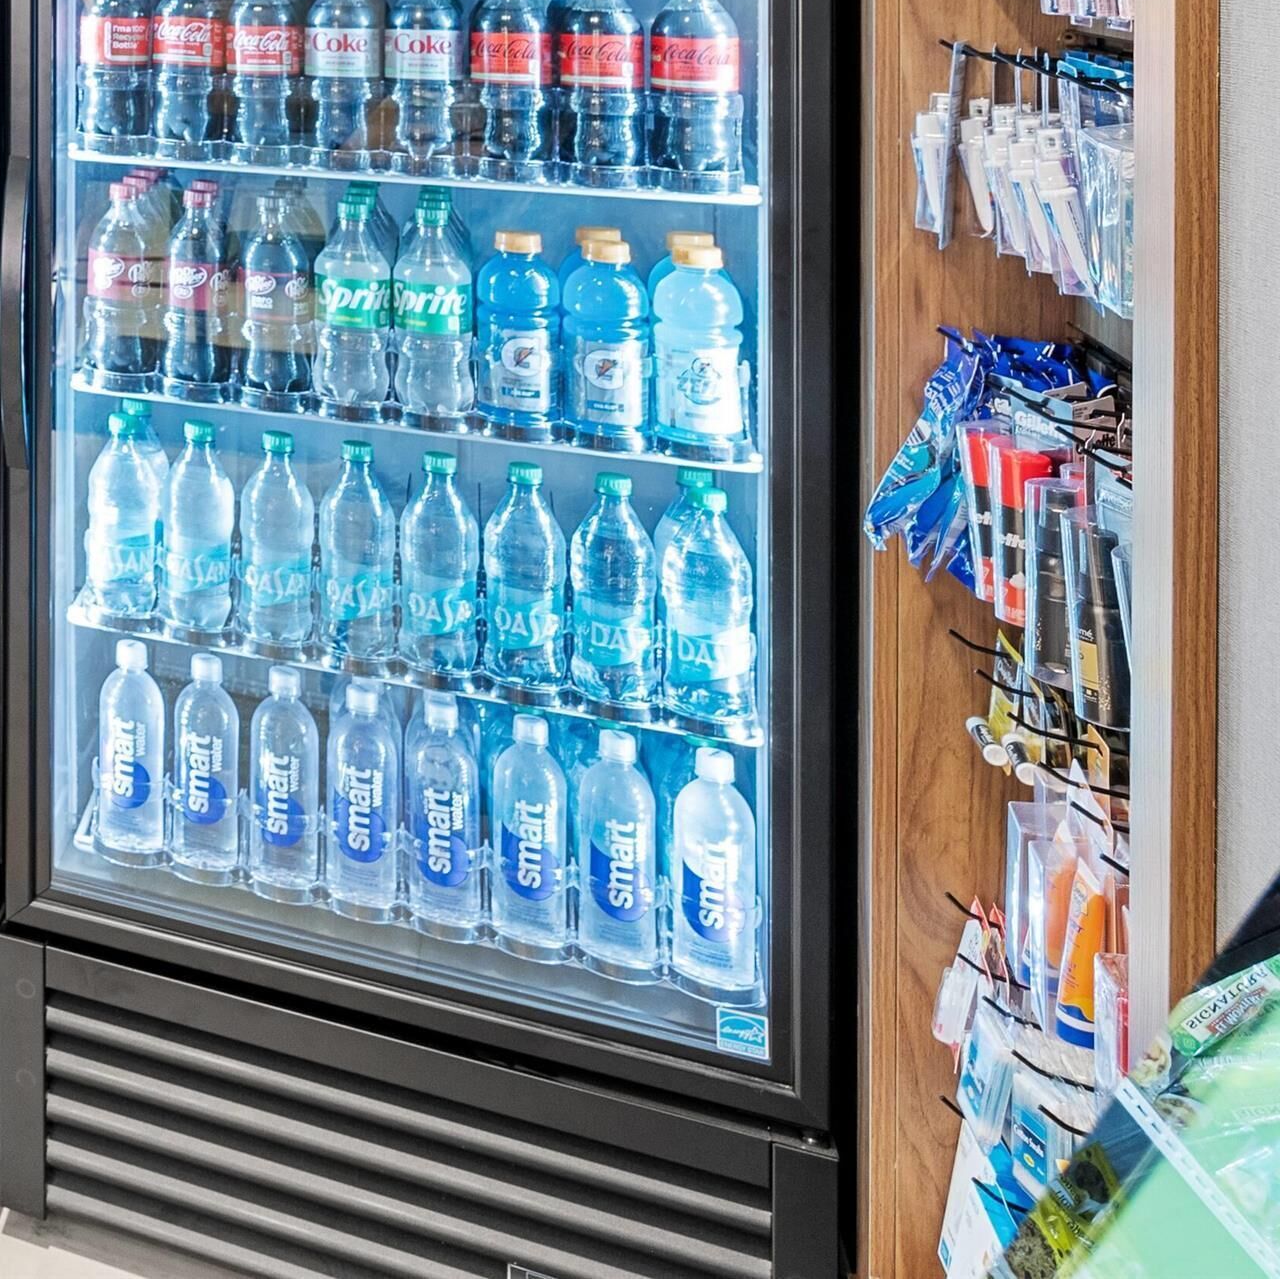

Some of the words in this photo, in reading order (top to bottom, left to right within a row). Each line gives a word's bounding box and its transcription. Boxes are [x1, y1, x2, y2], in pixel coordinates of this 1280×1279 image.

[158, 21, 212, 41] Coca-Cola
[233, 31, 289, 51] Coca-Cola
[312, 30, 367, 54] Coke
[393, 32, 452, 56] Coke
[319, 280, 390, 312] Sprite
[392, 283, 468, 317] Sprite
[112, 717, 135, 798] smart
[188, 731, 212, 814] smart
[211, 736, 223, 773] water
[266, 751, 290, 836] smart
[347, 765, 372, 852] smart
[371, 769, 384, 807] water
[427, 787, 452, 874] smart
[452, 791, 465, 831] water
[517, 799, 544, 889] smart
[608, 819, 635, 911] smart
